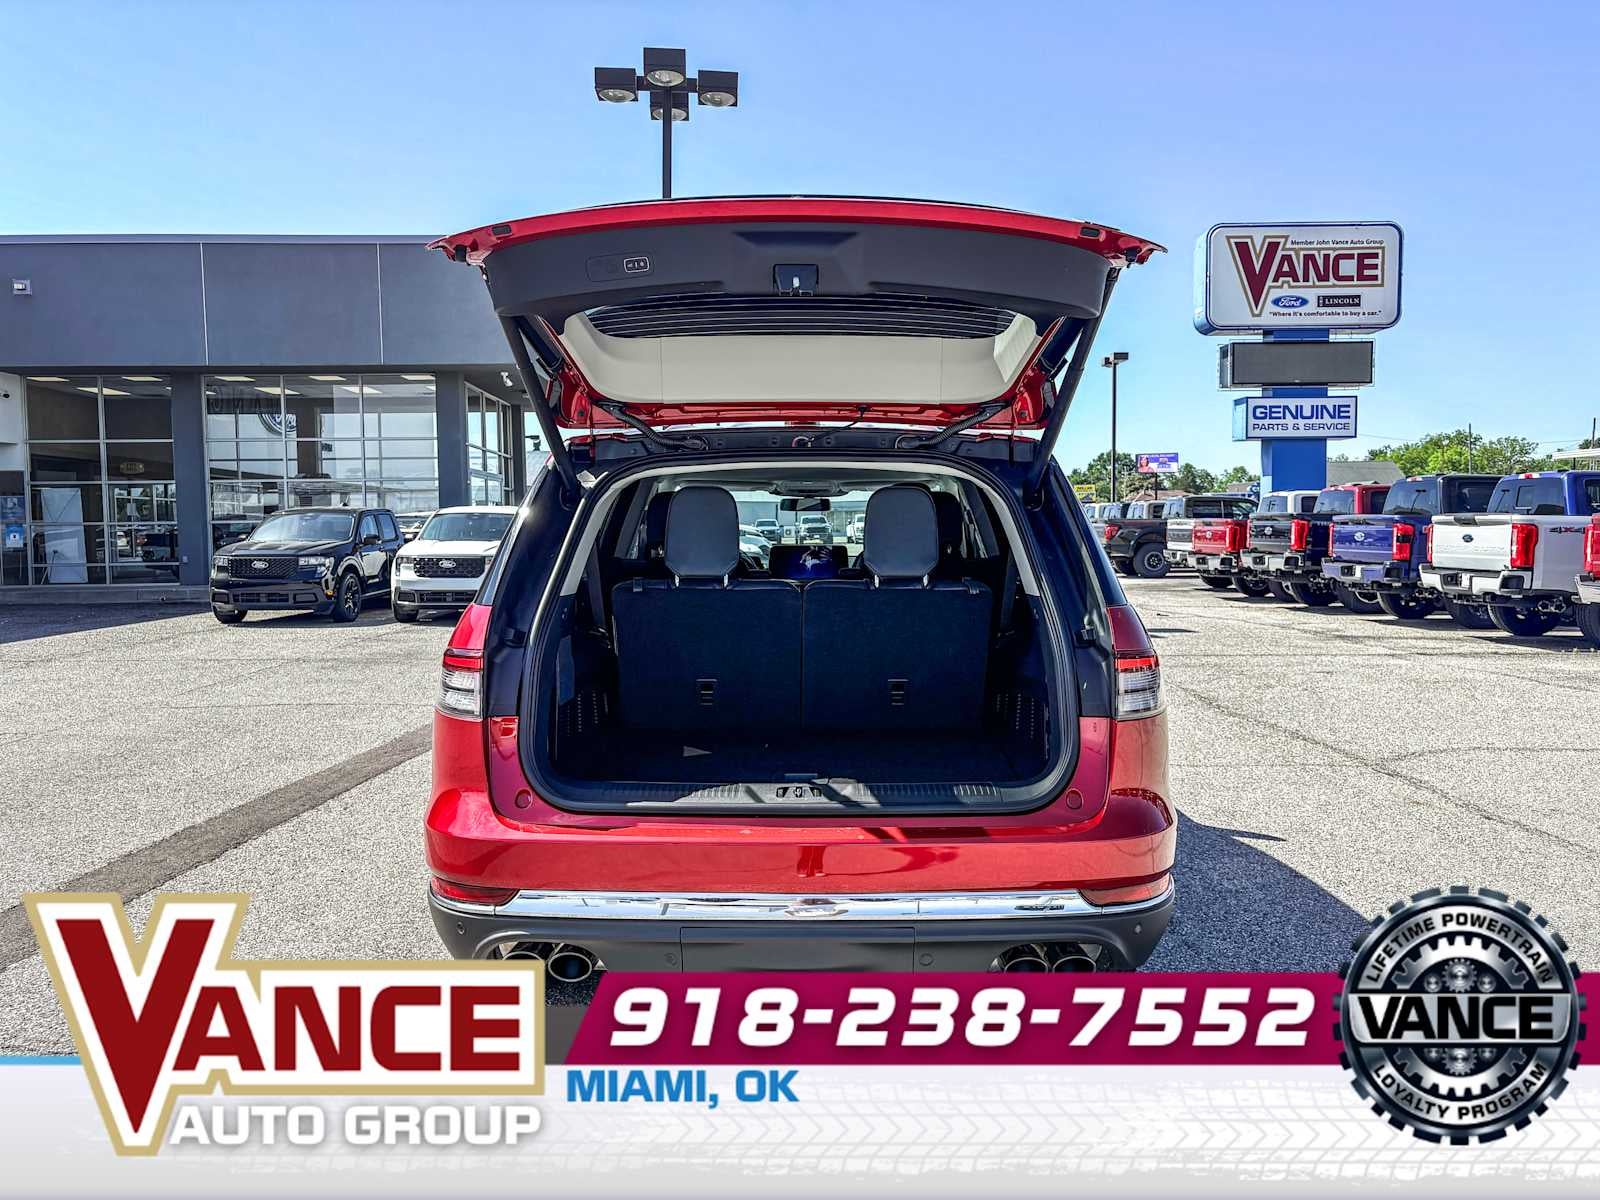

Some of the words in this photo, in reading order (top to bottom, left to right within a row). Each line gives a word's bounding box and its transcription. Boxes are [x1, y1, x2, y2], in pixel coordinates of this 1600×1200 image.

[1365, 238, 1385, 246] Group
[1278, 297, 1302, 307] Ford
[1325, 297, 1360, 305] LINCOLN
[1349, 310, 1361, 318] buy
[1252, 404, 1351, 420] GENUINE
[1252, 422, 1289, 431] PARTS
[1292, 422, 1301, 431] &
[1303, 422, 1351, 431] SERVICE
